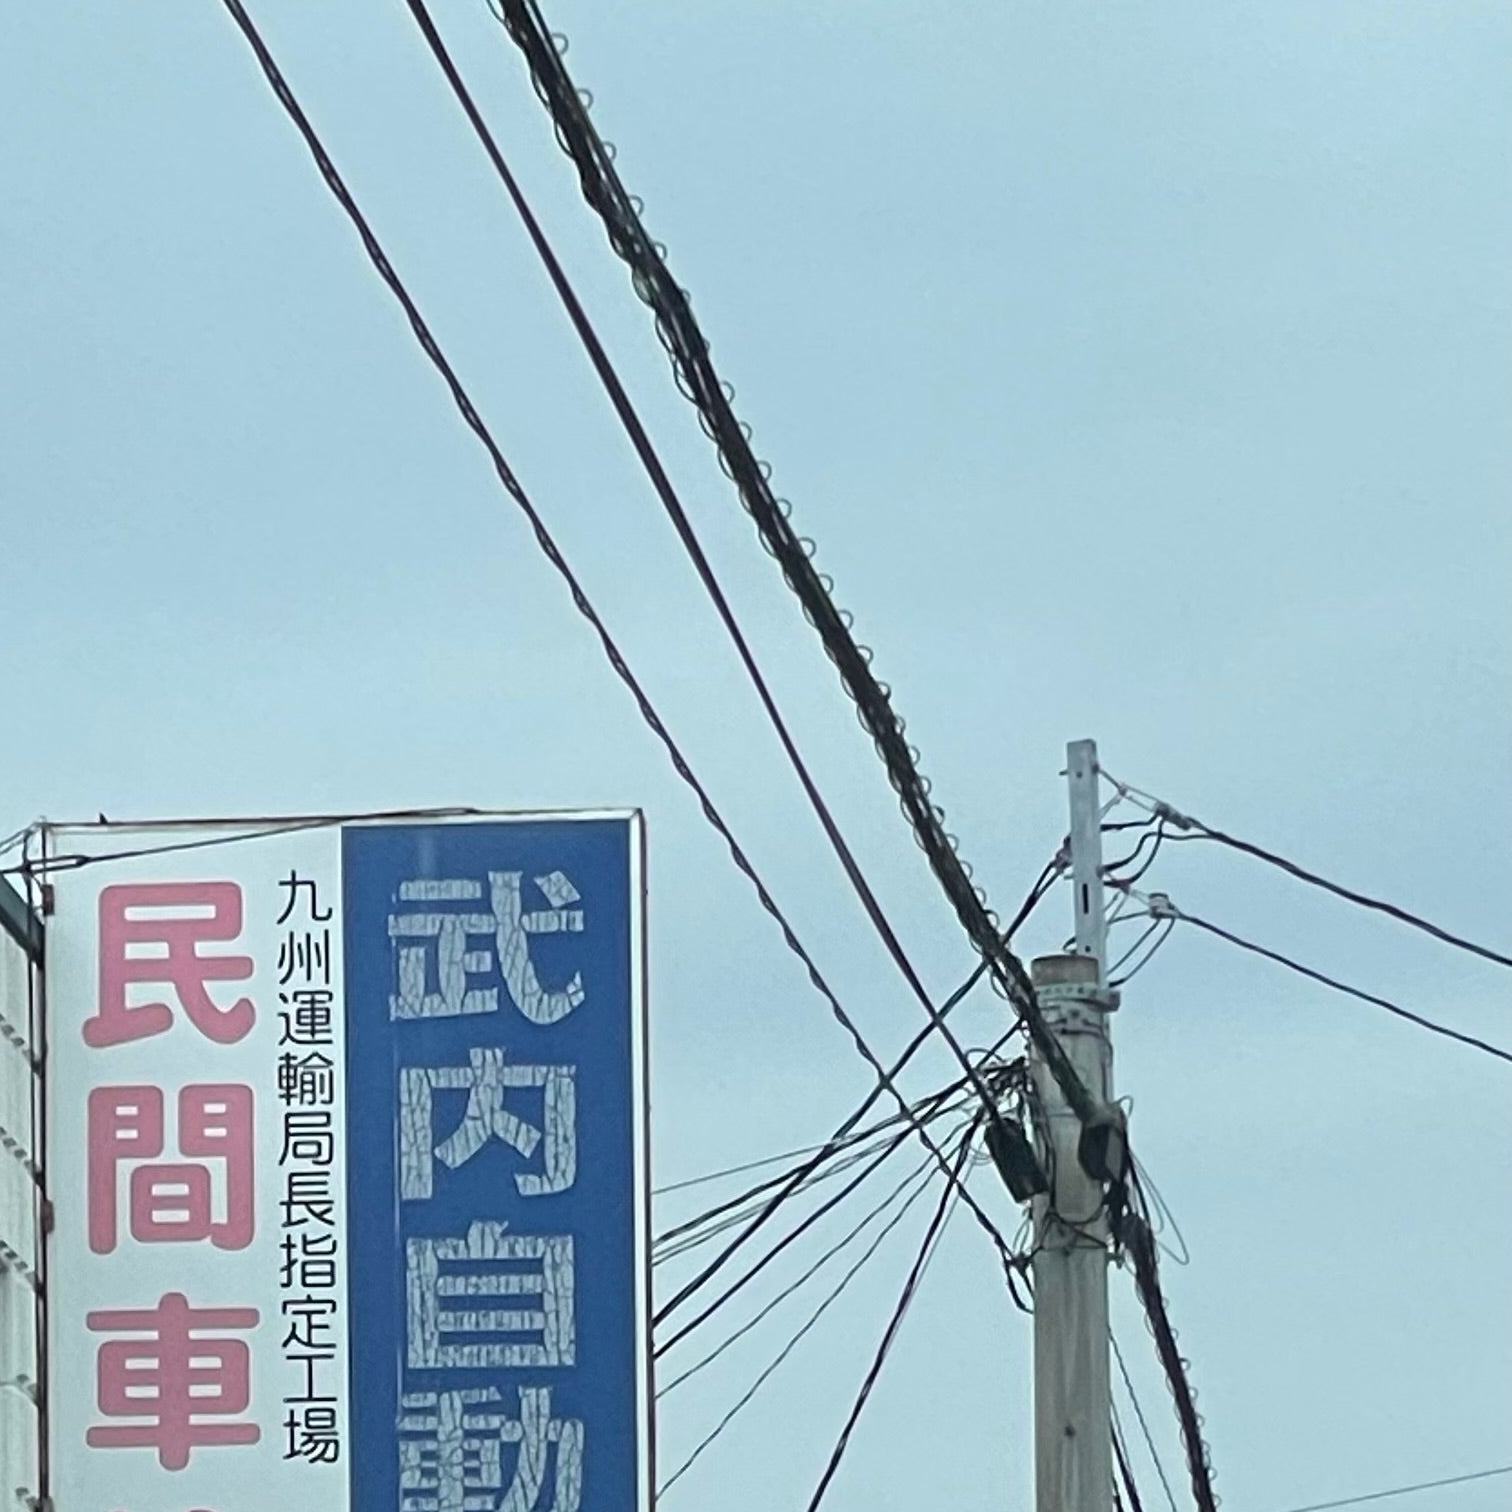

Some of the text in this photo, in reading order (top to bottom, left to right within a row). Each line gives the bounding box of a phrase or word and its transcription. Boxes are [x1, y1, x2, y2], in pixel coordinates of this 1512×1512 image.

[276, 869, 340, 1465] 九州運輸局長指定工場
